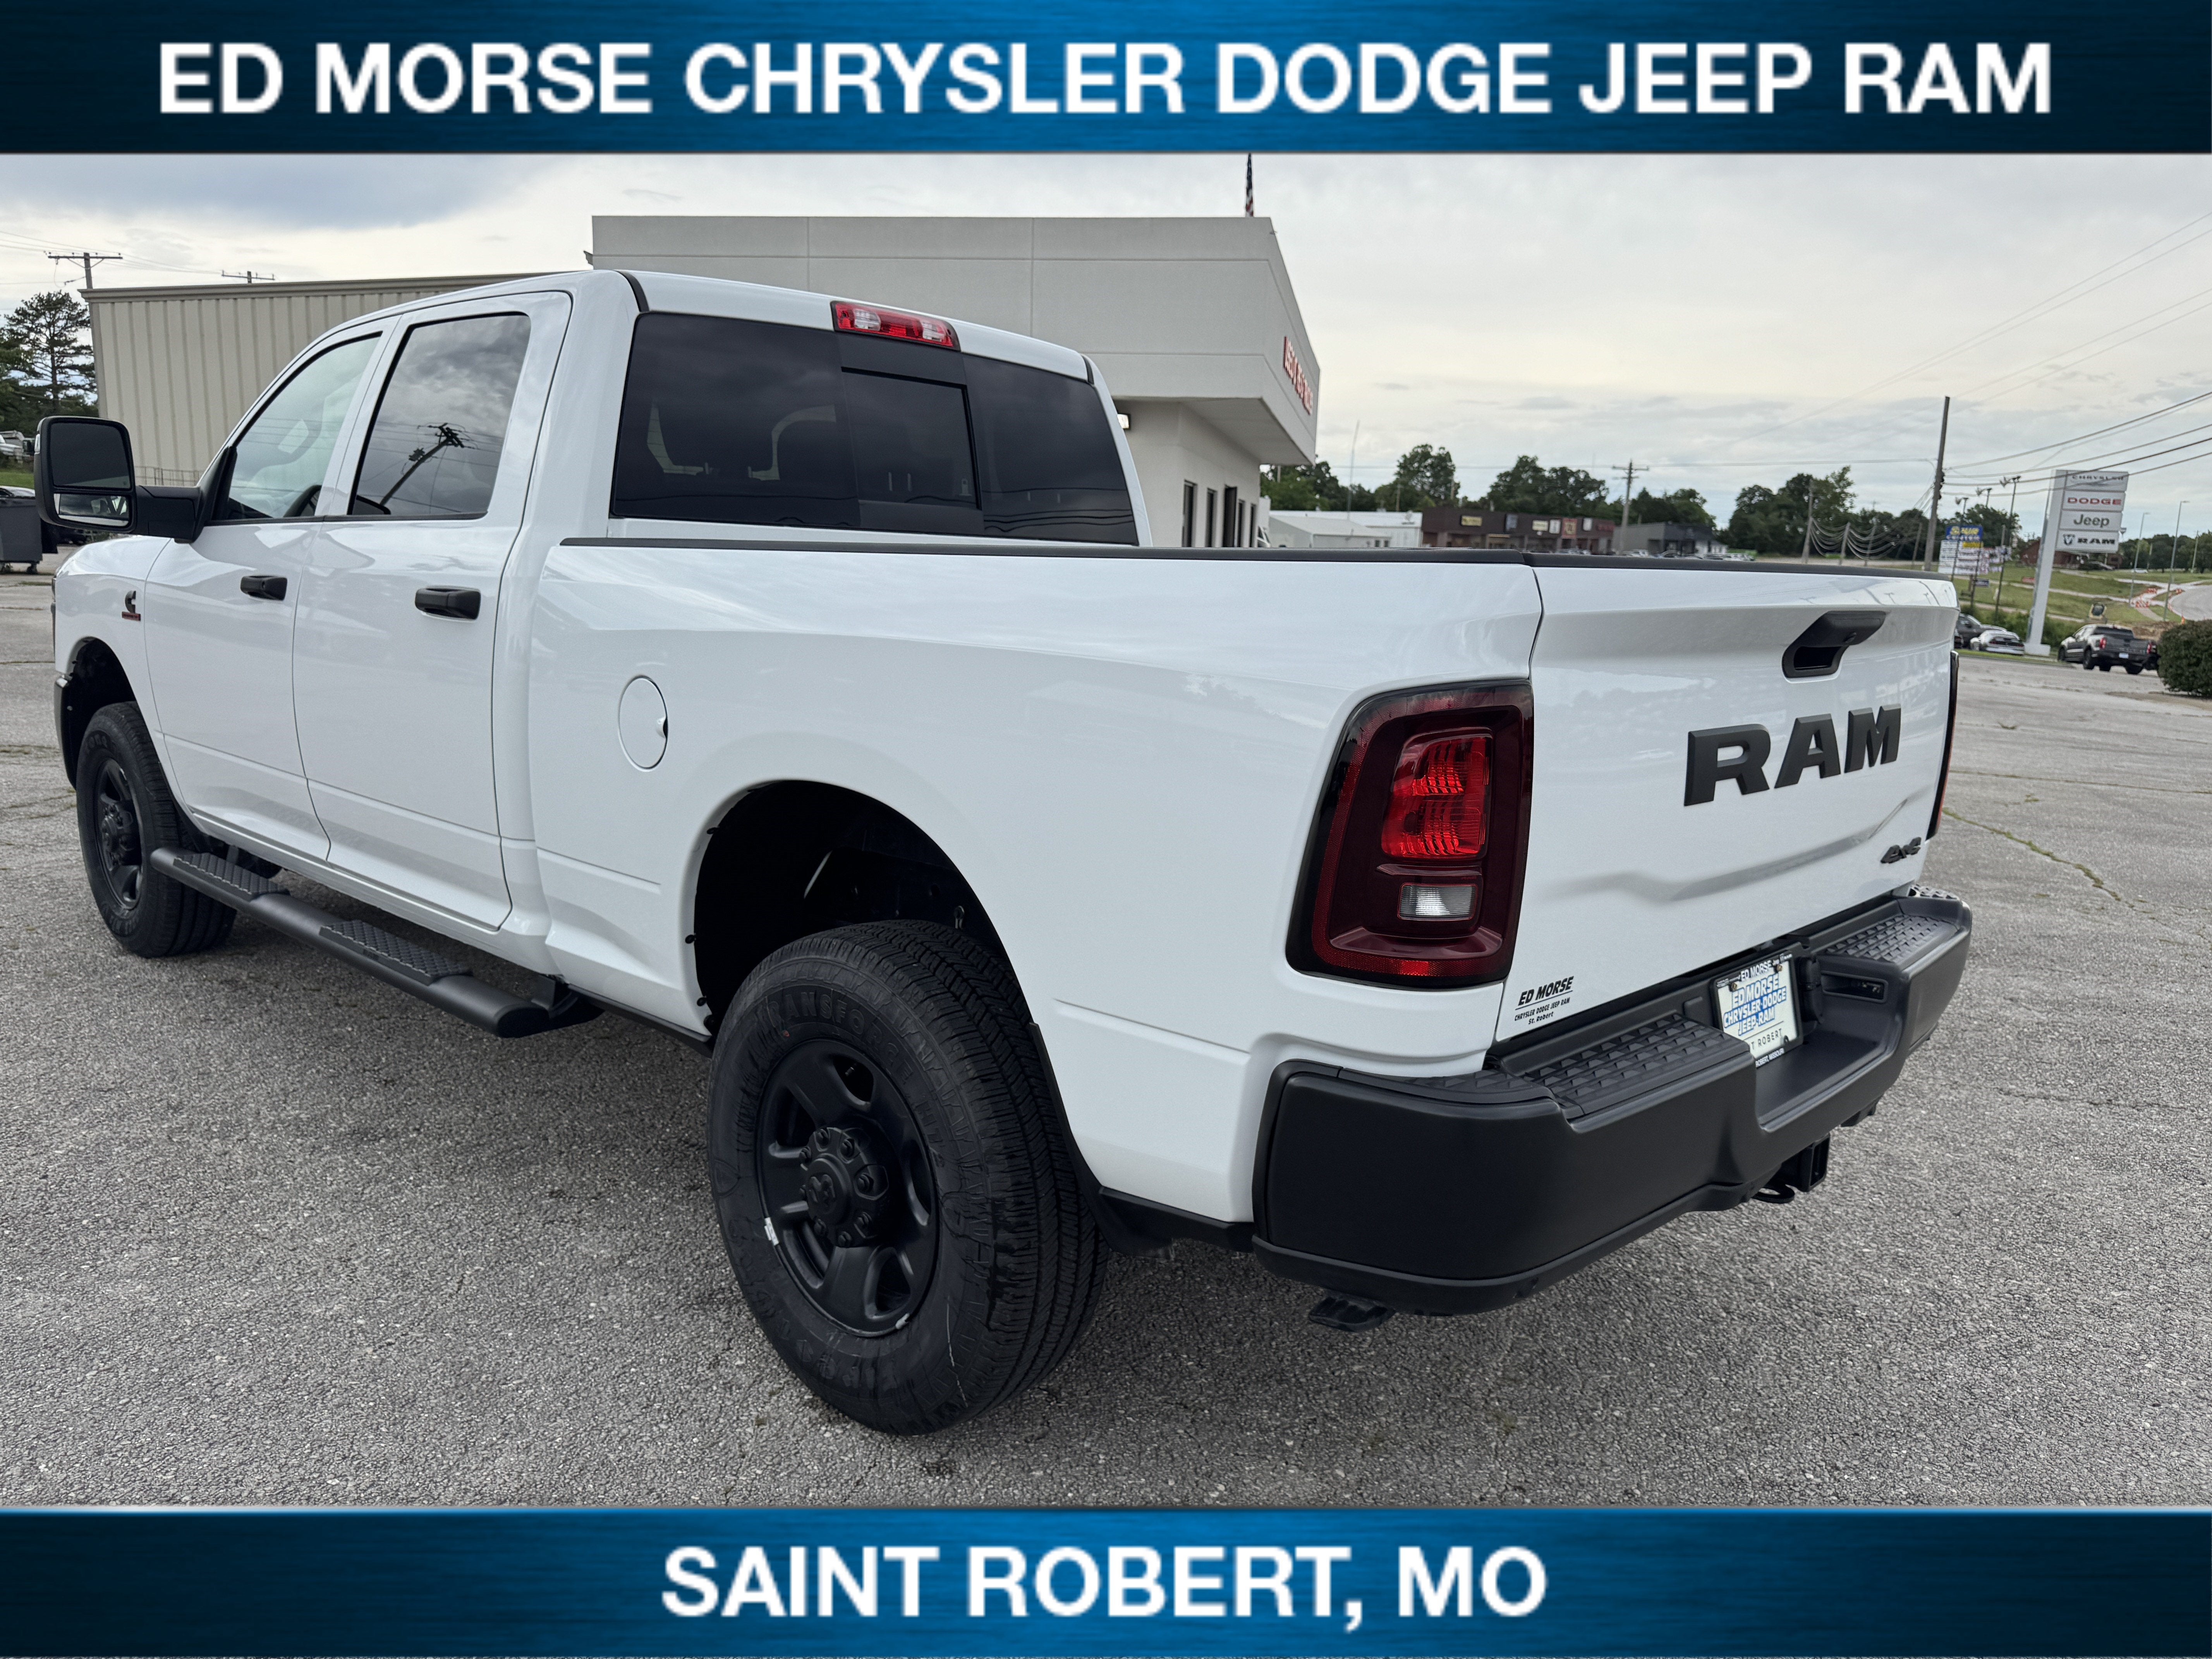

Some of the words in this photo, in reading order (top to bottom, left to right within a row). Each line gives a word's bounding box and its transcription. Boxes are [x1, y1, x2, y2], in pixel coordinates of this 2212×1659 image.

[2067, 497, 2122, 505] DODGE
[2073, 514, 2110, 529] Jeep
[2077, 537, 2115, 545] RAM
[1684, 703, 1901, 806] RAM
[1740, 969, 1750, 982] ED
[1750, 960, 1772, 978] MORSE
[1518, 989, 1535, 1006] ED
[1535, 975, 1574, 1000] MORSE
[1732, 987, 1745, 1008] ED
[1745, 974, 1779, 1001] MORSE
[1515, 1009, 1535, 1021] CHRYSLER
[1536, 1004, 1549, 1015] DODGE
[1550, 1001, 1560, 1010] JEEP
[1561, 997, 1570, 1006] RAM
[1536, 1012, 1554, 1022] Robert
[1724, 1001, 1762, 1028] CHRYSLER
[1763, 986, 1786, 1009] DODGE
[1738, 1017, 1756, 1036] JEEP
[1758, 1006, 1775, 1026] RAM
[1758, 1028, 1782, 1047] ROBERT
